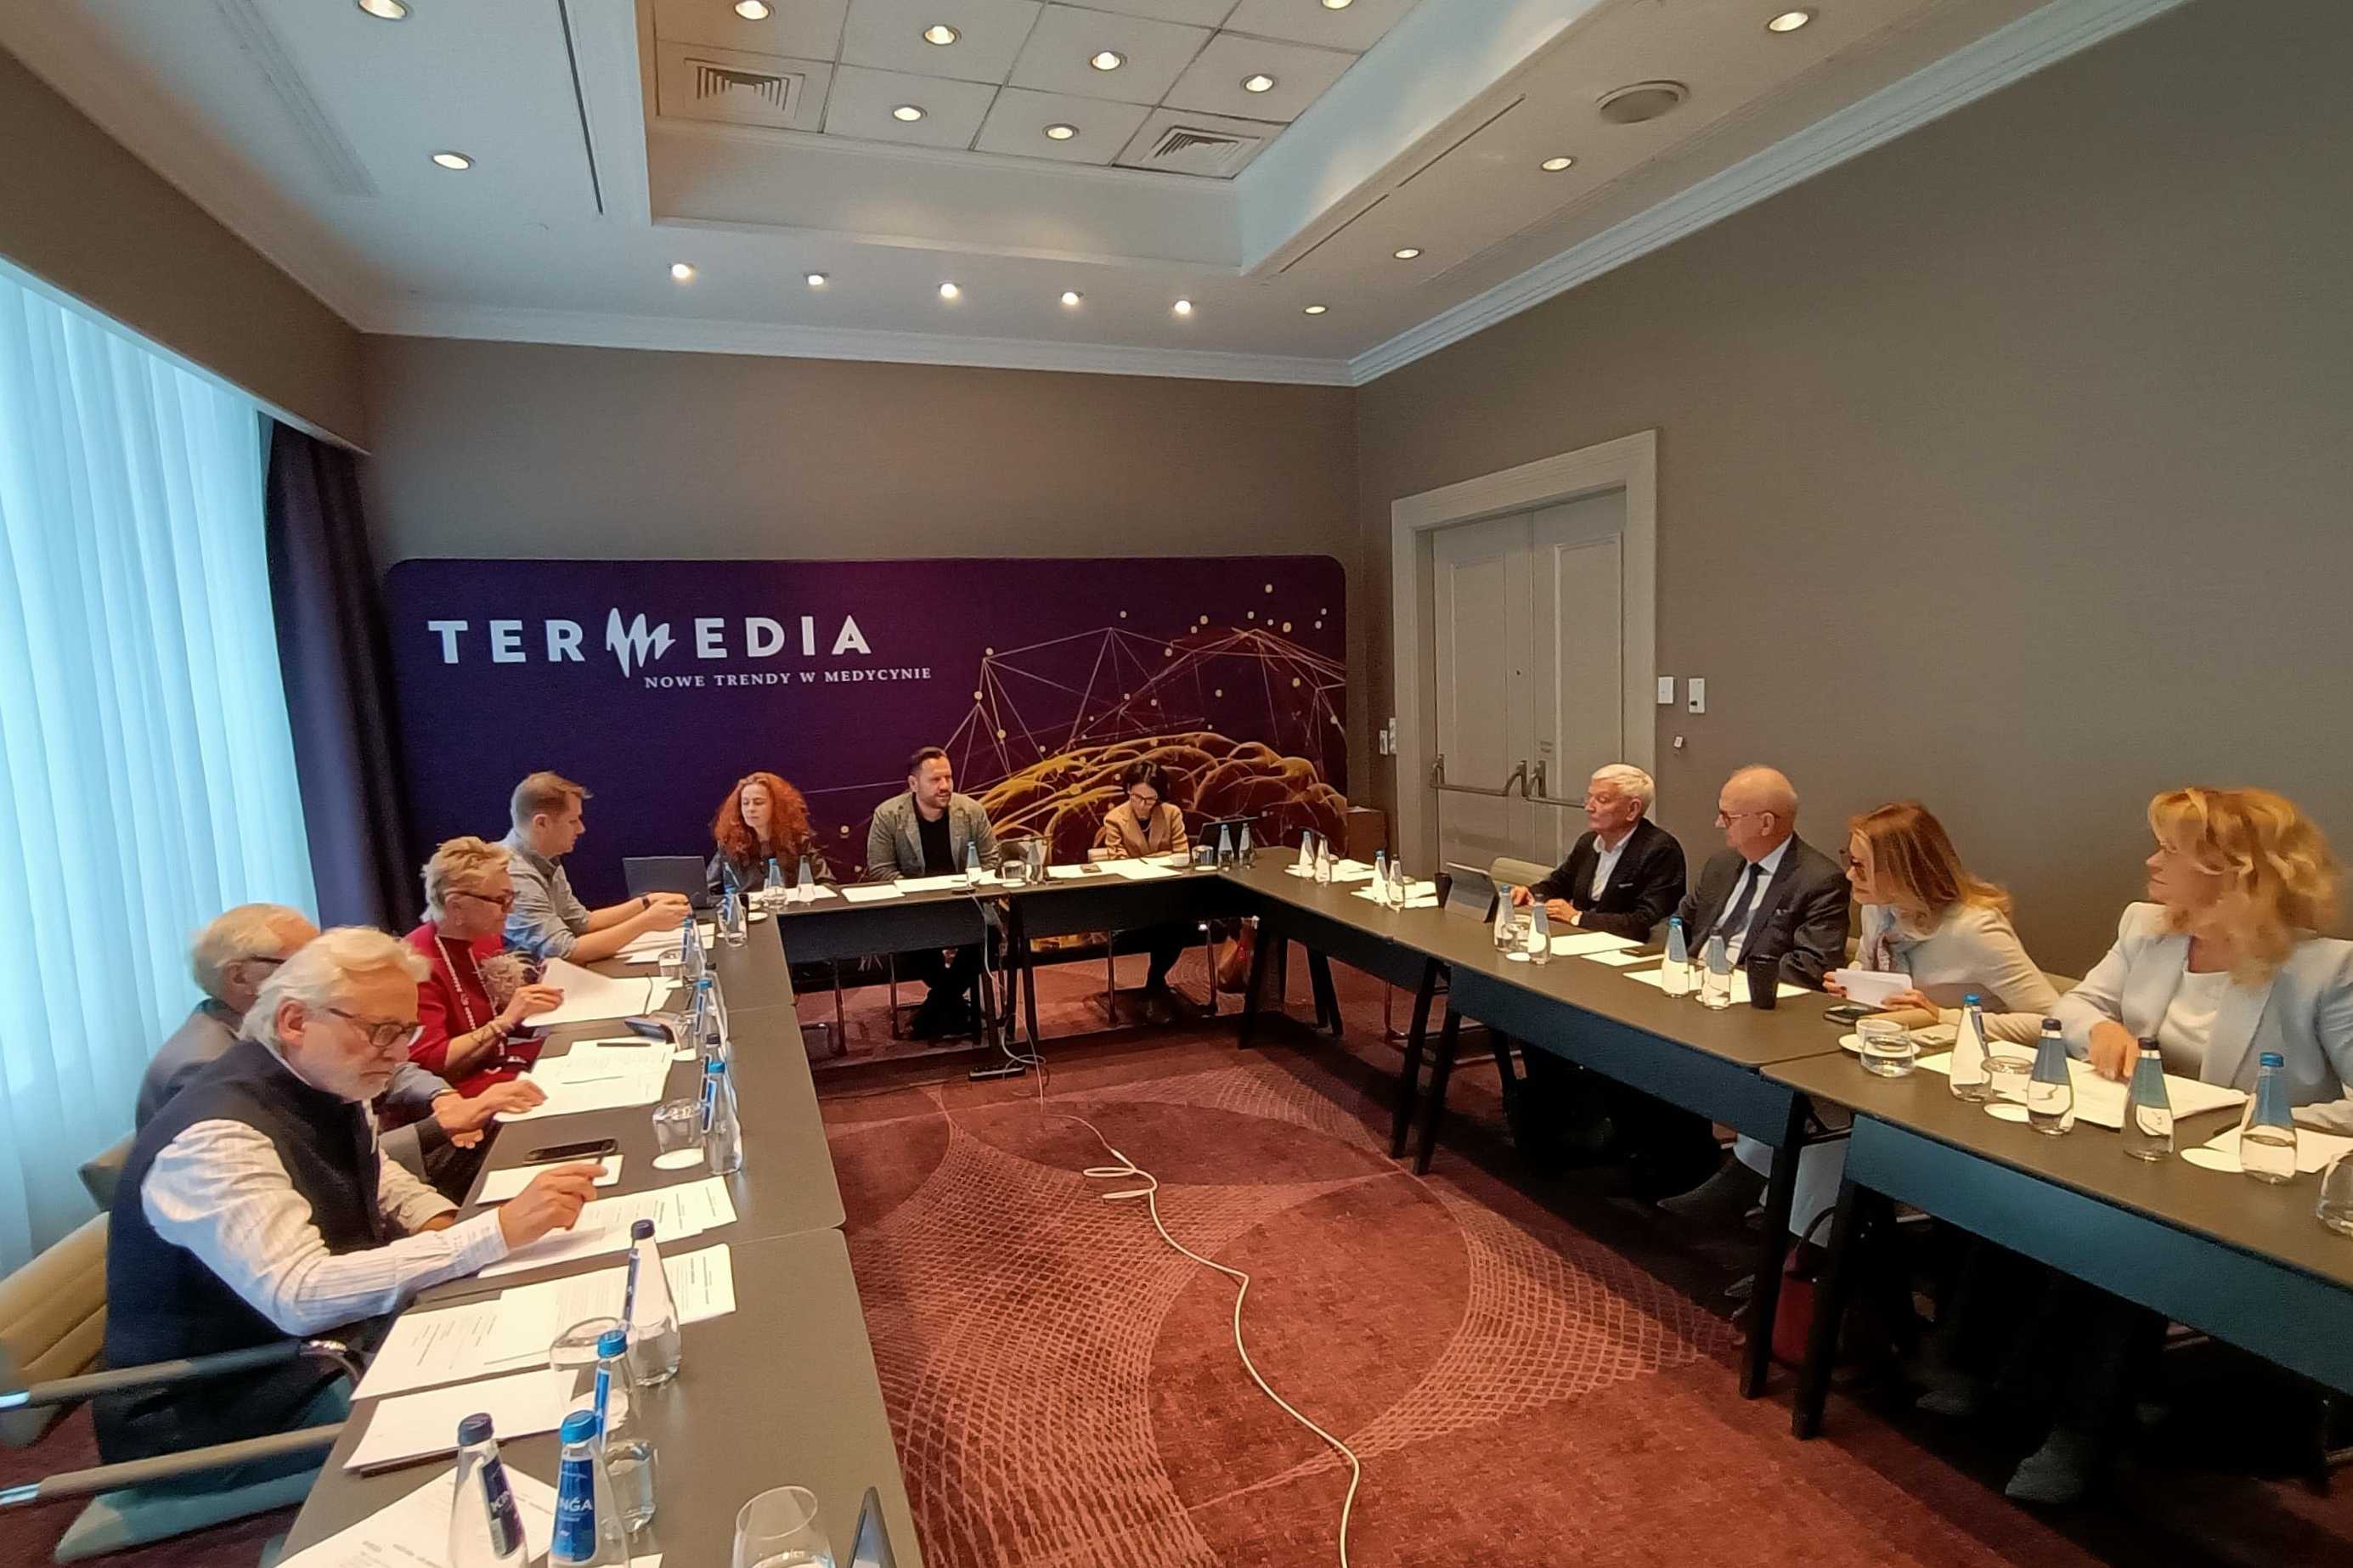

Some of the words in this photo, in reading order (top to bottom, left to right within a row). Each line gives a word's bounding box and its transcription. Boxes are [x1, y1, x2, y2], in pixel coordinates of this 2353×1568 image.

[427, 607, 872, 678] TERMEDIA
[644, 675, 706, 689] NOWE
[714, 673, 791, 686] TRENDY
[799, 672, 816, 683] W
[824, 668, 932, 683] MEDYCYNIE
